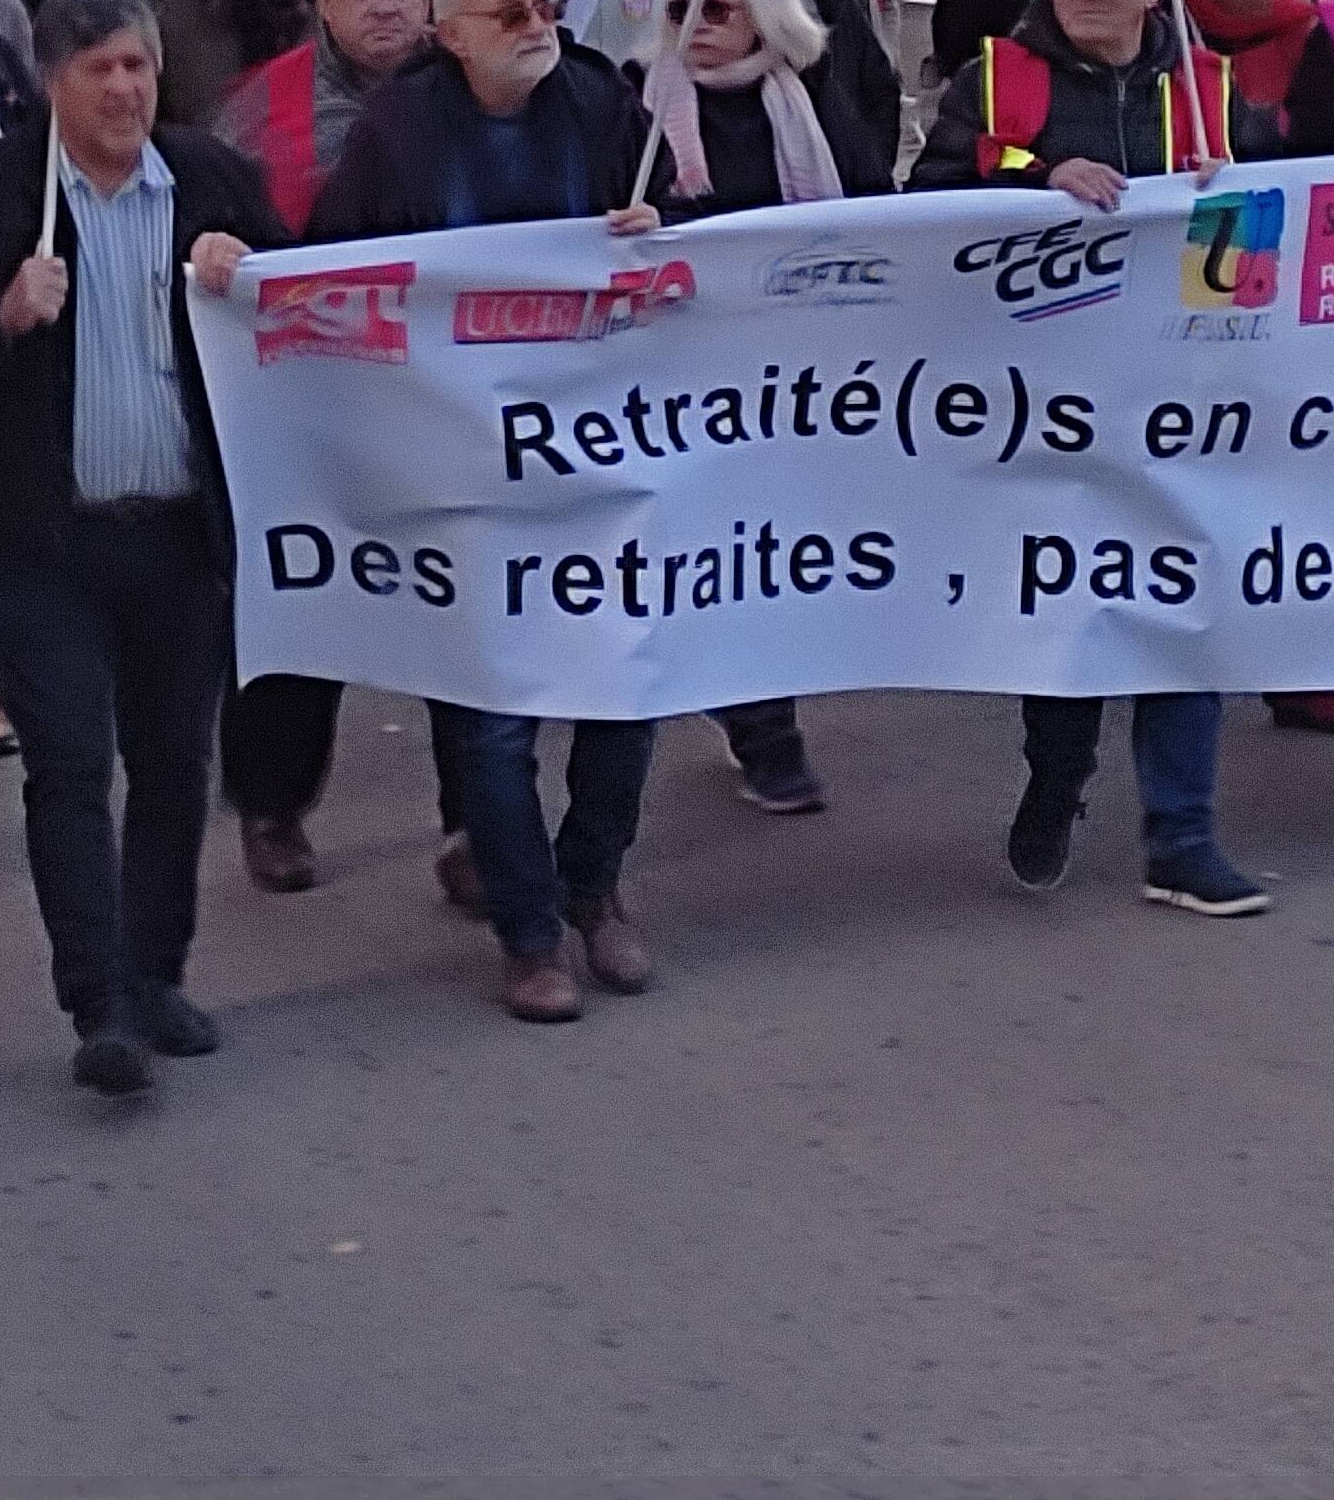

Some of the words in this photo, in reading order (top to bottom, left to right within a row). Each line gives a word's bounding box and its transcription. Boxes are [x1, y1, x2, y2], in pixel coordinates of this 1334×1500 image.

[953, 215, 1084, 274] CFE
[994, 230, 1132, 303] CGC
[501, 358, 1095, 482] Retraité(e)s
[1145, 399, 1252, 458] en
[265, 523, 456, 608] Des
[505, 520, 896, 618] retraites
[1019, 535, 1198, 617] pas
